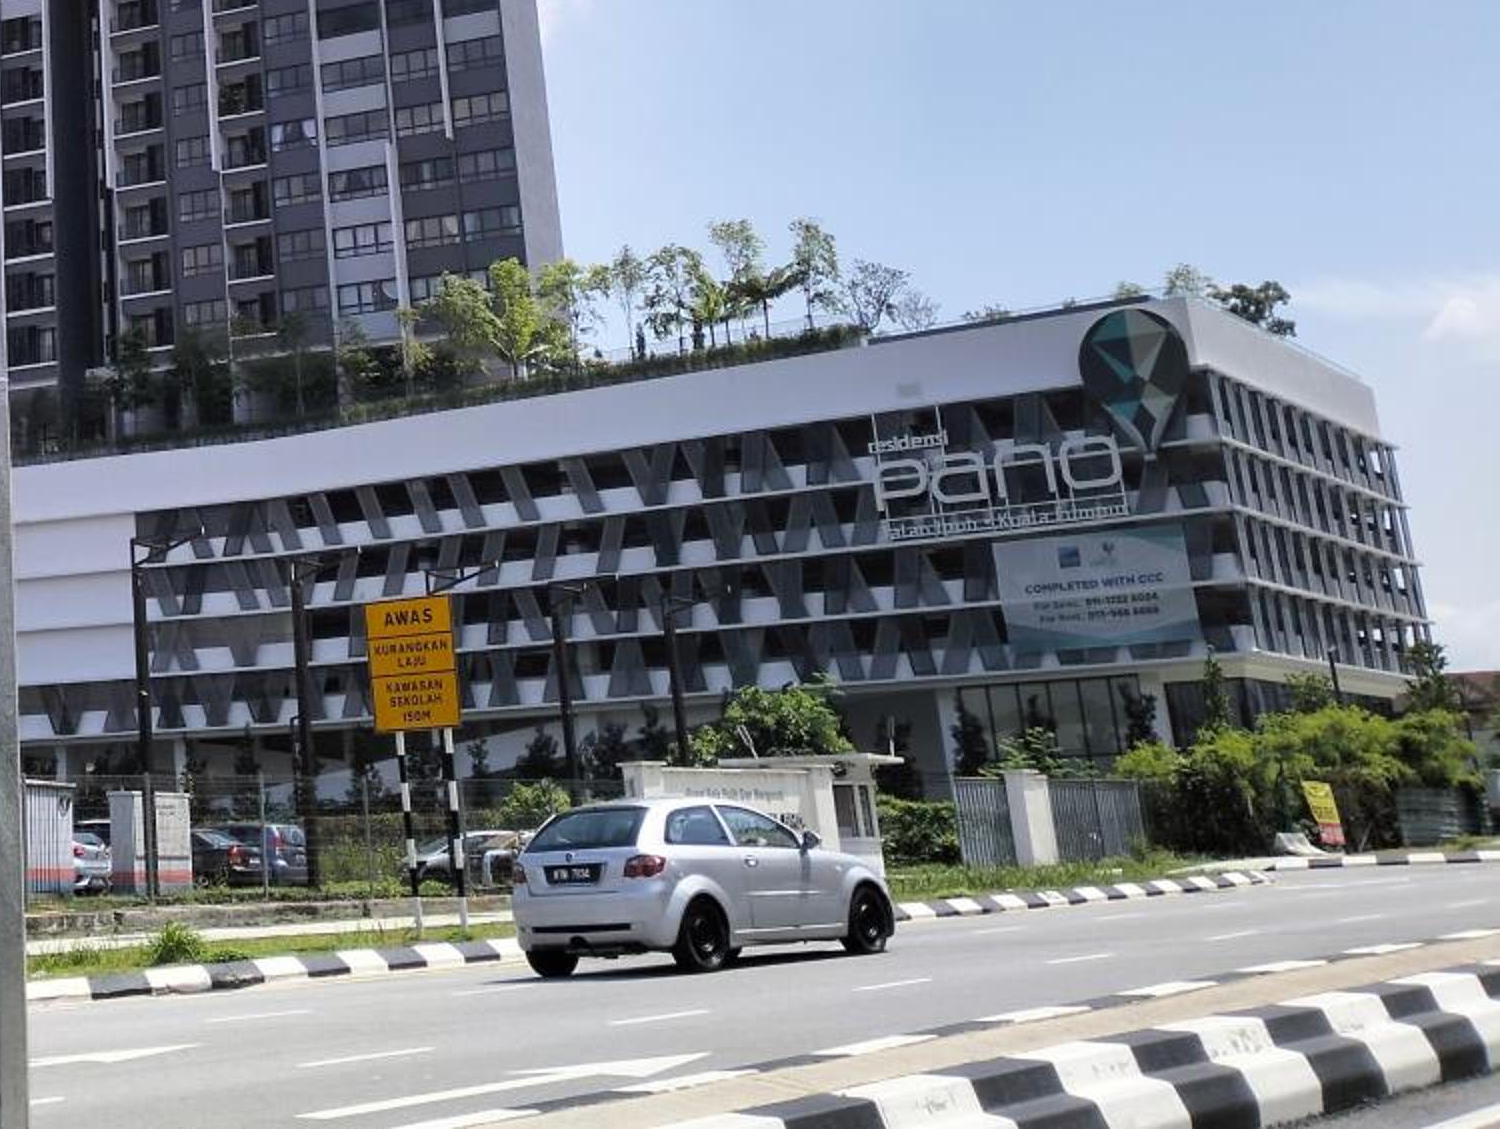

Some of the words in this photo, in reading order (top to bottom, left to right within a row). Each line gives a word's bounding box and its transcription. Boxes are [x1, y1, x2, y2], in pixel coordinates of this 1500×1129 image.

[1025, 579, 1098, 595] COMPLETED
[1101, 574, 1135, 589] WITH
[384, 608, 433, 626] AWAS
[374, 639, 447, 656] KURANGKAN
[397, 656, 427, 668] LAJU
[386, 679, 443, 693] KAWASAN
[389, 693, 443, 708] SEKOLAH
